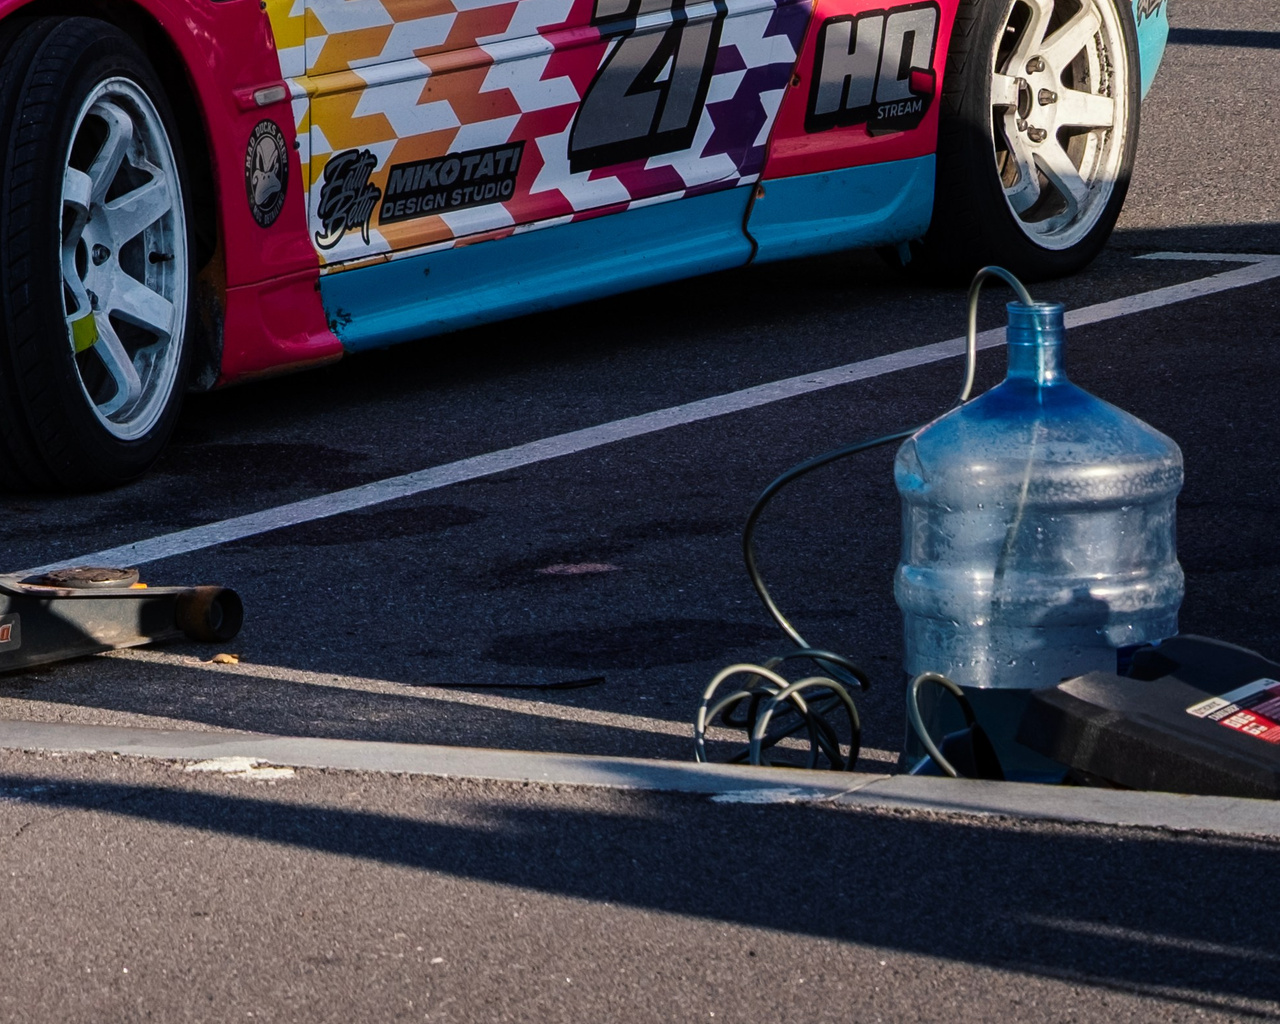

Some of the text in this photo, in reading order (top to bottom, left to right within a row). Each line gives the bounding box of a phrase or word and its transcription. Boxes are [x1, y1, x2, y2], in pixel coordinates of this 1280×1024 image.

[877, 99, 923, 120] STREAM
[246, 121, 288, 168] MAD DUCKS CREW
[387, 147, 520, 195] MIKOTATI
[382, 179, 514, 219] DESIGN STUDIO
